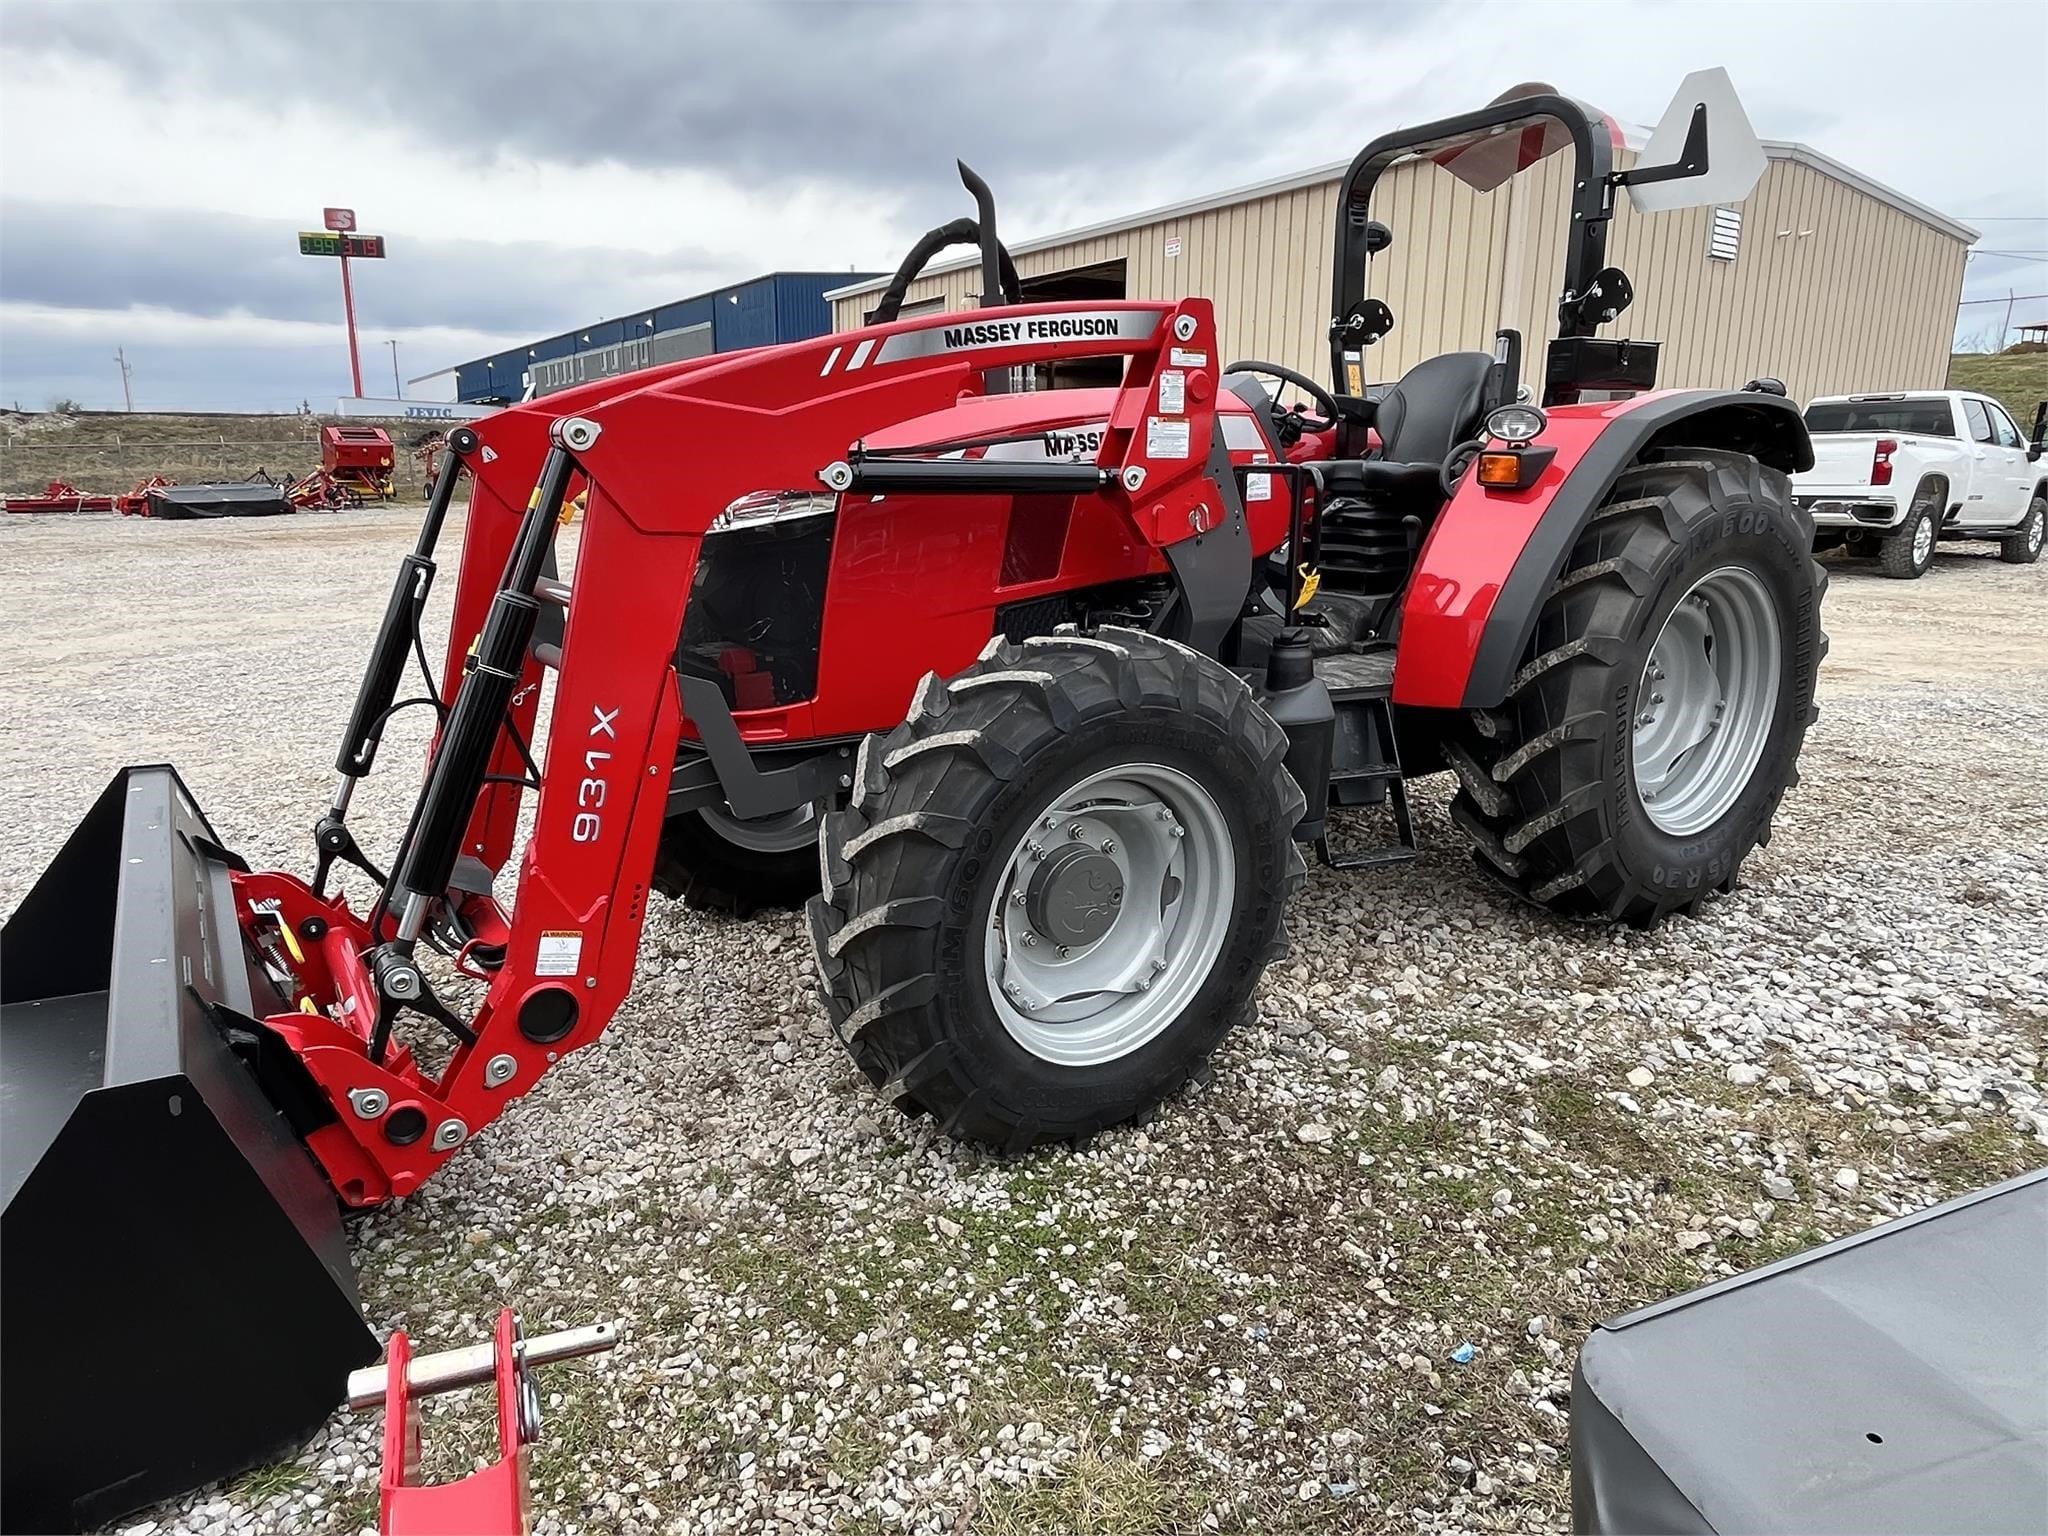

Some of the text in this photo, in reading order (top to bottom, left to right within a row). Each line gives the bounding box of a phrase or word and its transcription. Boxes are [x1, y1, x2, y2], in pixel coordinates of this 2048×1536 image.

[944, 318, 1119, 348] MASSEY FERGUSON
[404, 406, 452, 418] JEVIC
[572, 704, 620, 842] 931 X
